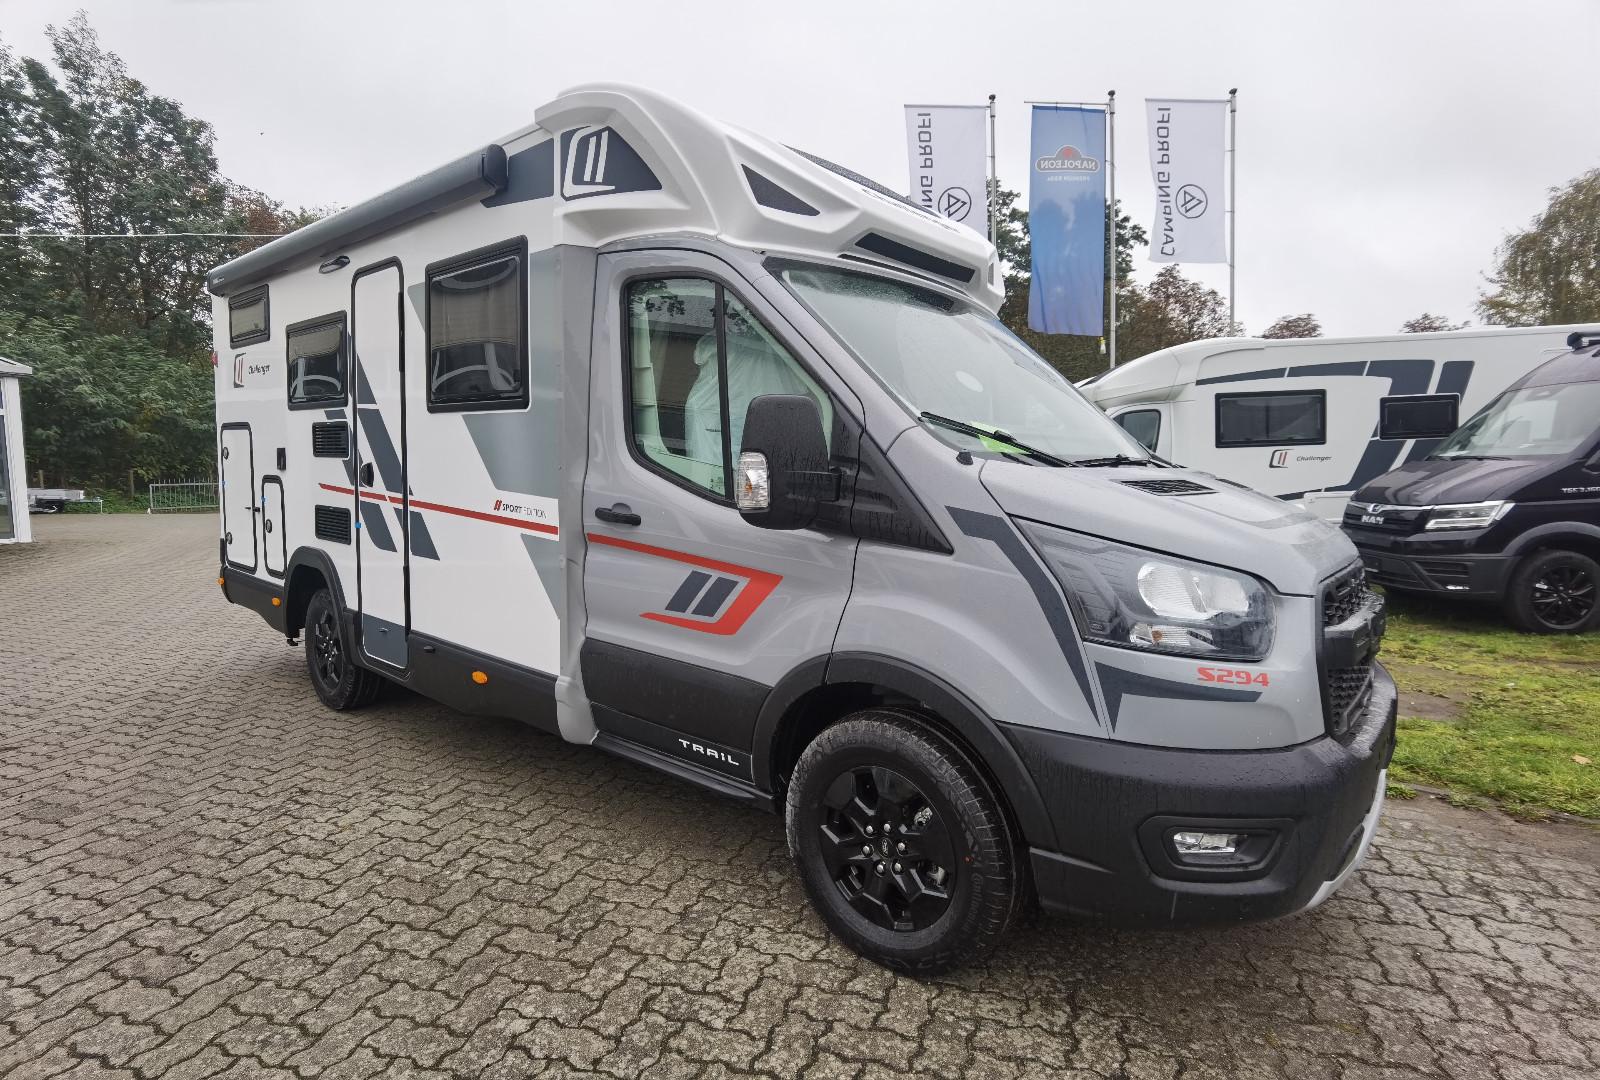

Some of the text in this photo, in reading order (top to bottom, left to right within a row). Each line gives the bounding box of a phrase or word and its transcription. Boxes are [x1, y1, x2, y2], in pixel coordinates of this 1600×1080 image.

[502, 503, 523, 514] SPORT
[1361, 515, 1385, 525] MAN
[1197, 666, 1270, 687] S294
[678, 738, 740, 766] TRAIL
